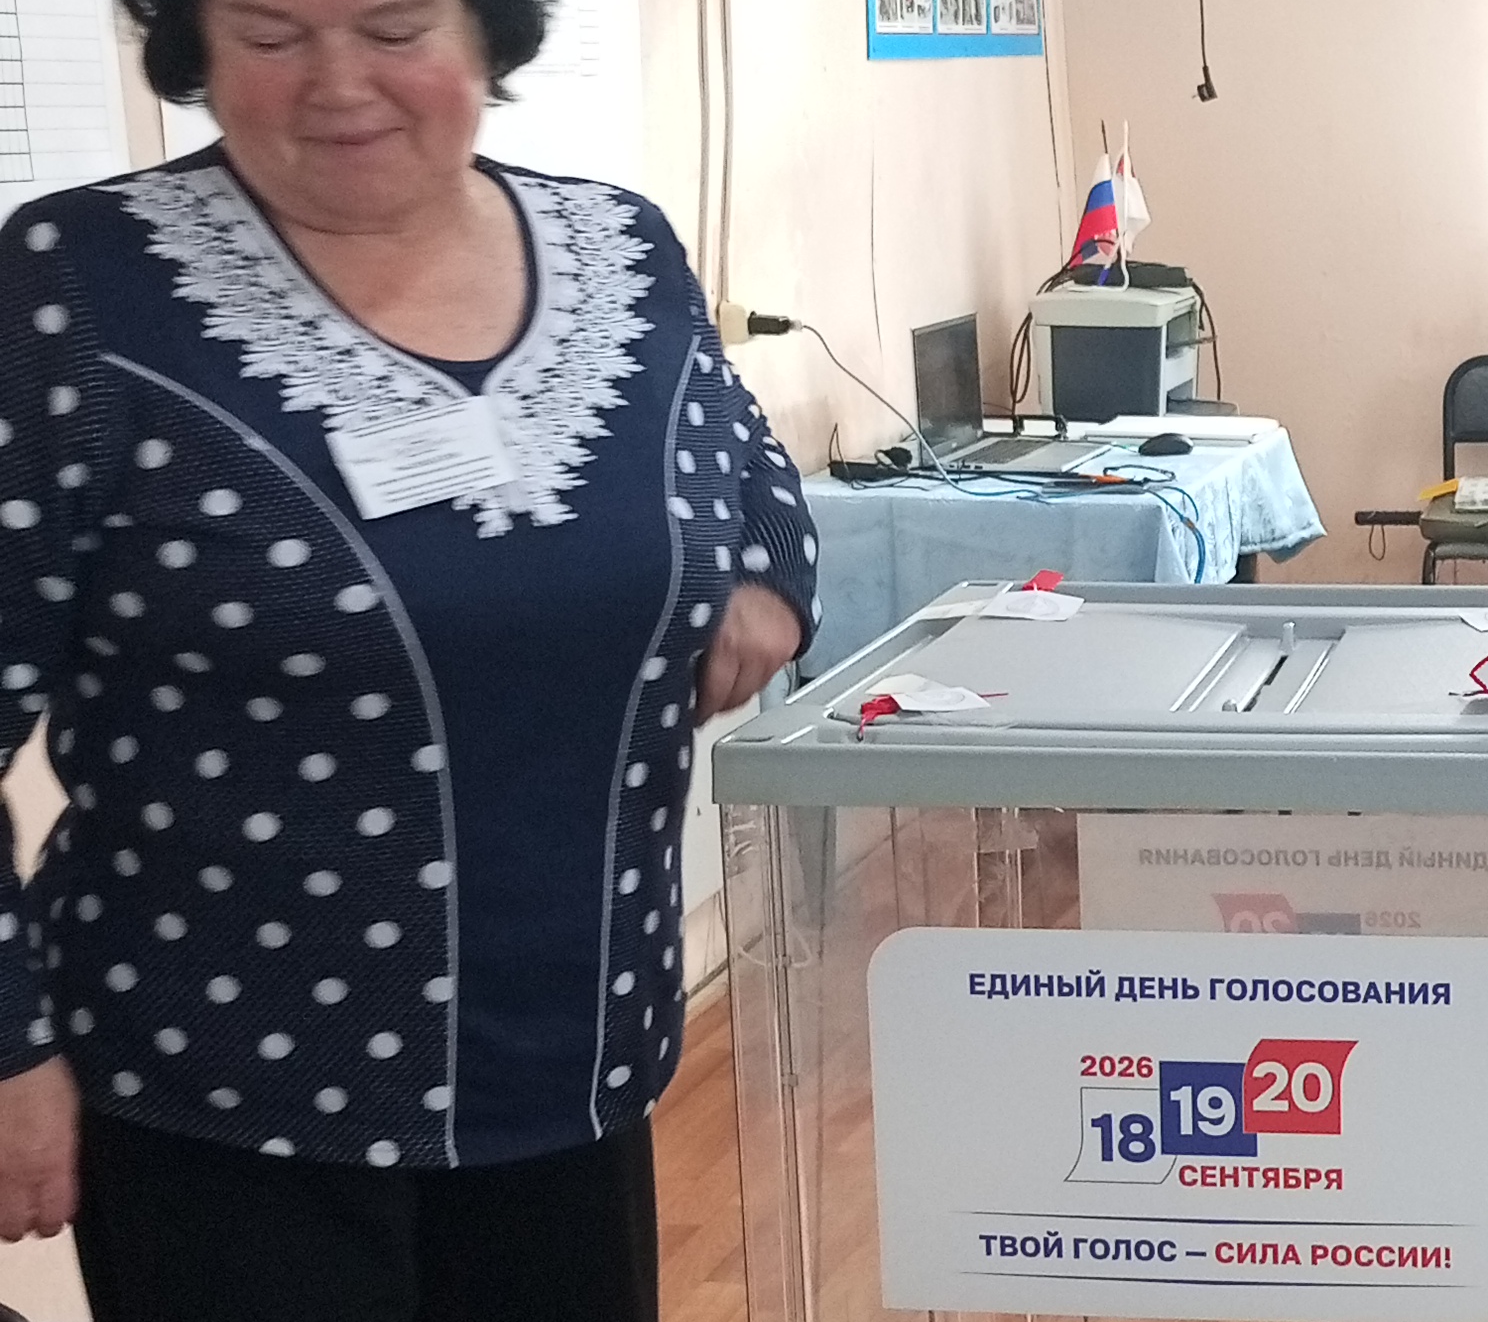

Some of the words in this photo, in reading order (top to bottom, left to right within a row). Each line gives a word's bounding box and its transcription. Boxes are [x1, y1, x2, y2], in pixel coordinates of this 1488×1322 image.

[968, 968, 1106, 1001] ЕДИНЫЙ
[1114, 975, 1201, 1003] ДЕНЬ
[1209, 977, 1451, 1006] ГОЛОСОВАНИЯ
[1079, 1054, 1154, 1079] 2026
[1090, 1113, 1157, 1164] 18
[1170, 1086, 1236, 1136] 19
[1252, 1061, 1333, 1113] 20
[1178, 1164, 1343, 1191] СЕНТЯБРЯ
[978, 1230, 1064, 1259] ТВОЙ
[1072, 1237, 1178, 1263] ГОЛОС
[1214, 1241, 1303, 1267] СИЛА
[1310, 1244, 1452, 1270] РОССИИ!
